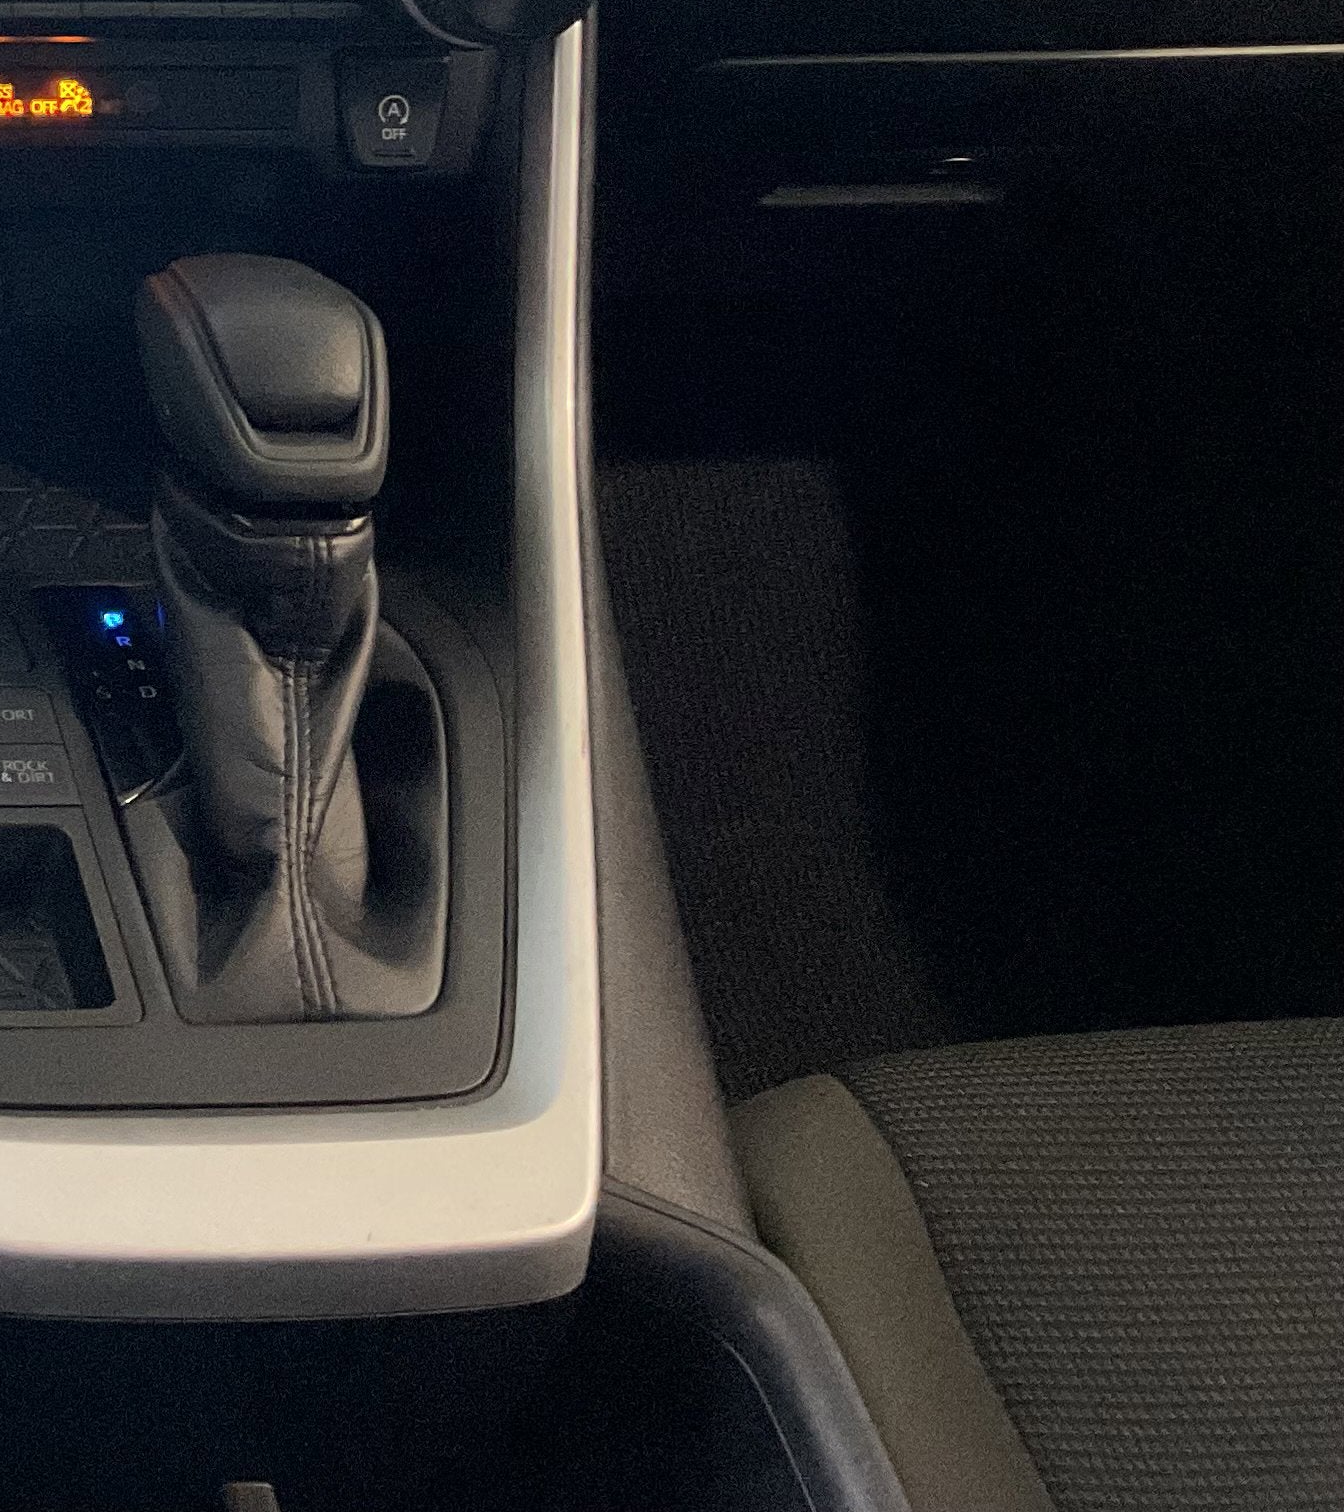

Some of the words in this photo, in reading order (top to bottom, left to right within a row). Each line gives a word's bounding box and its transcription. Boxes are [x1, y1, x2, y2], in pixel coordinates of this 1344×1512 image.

[29, 99, 59, 115] OFF
[381, 127, 408, 141] OFF
[2, 759, 49, 772] ROCK
[17, 771, 55, 784] DIRT
